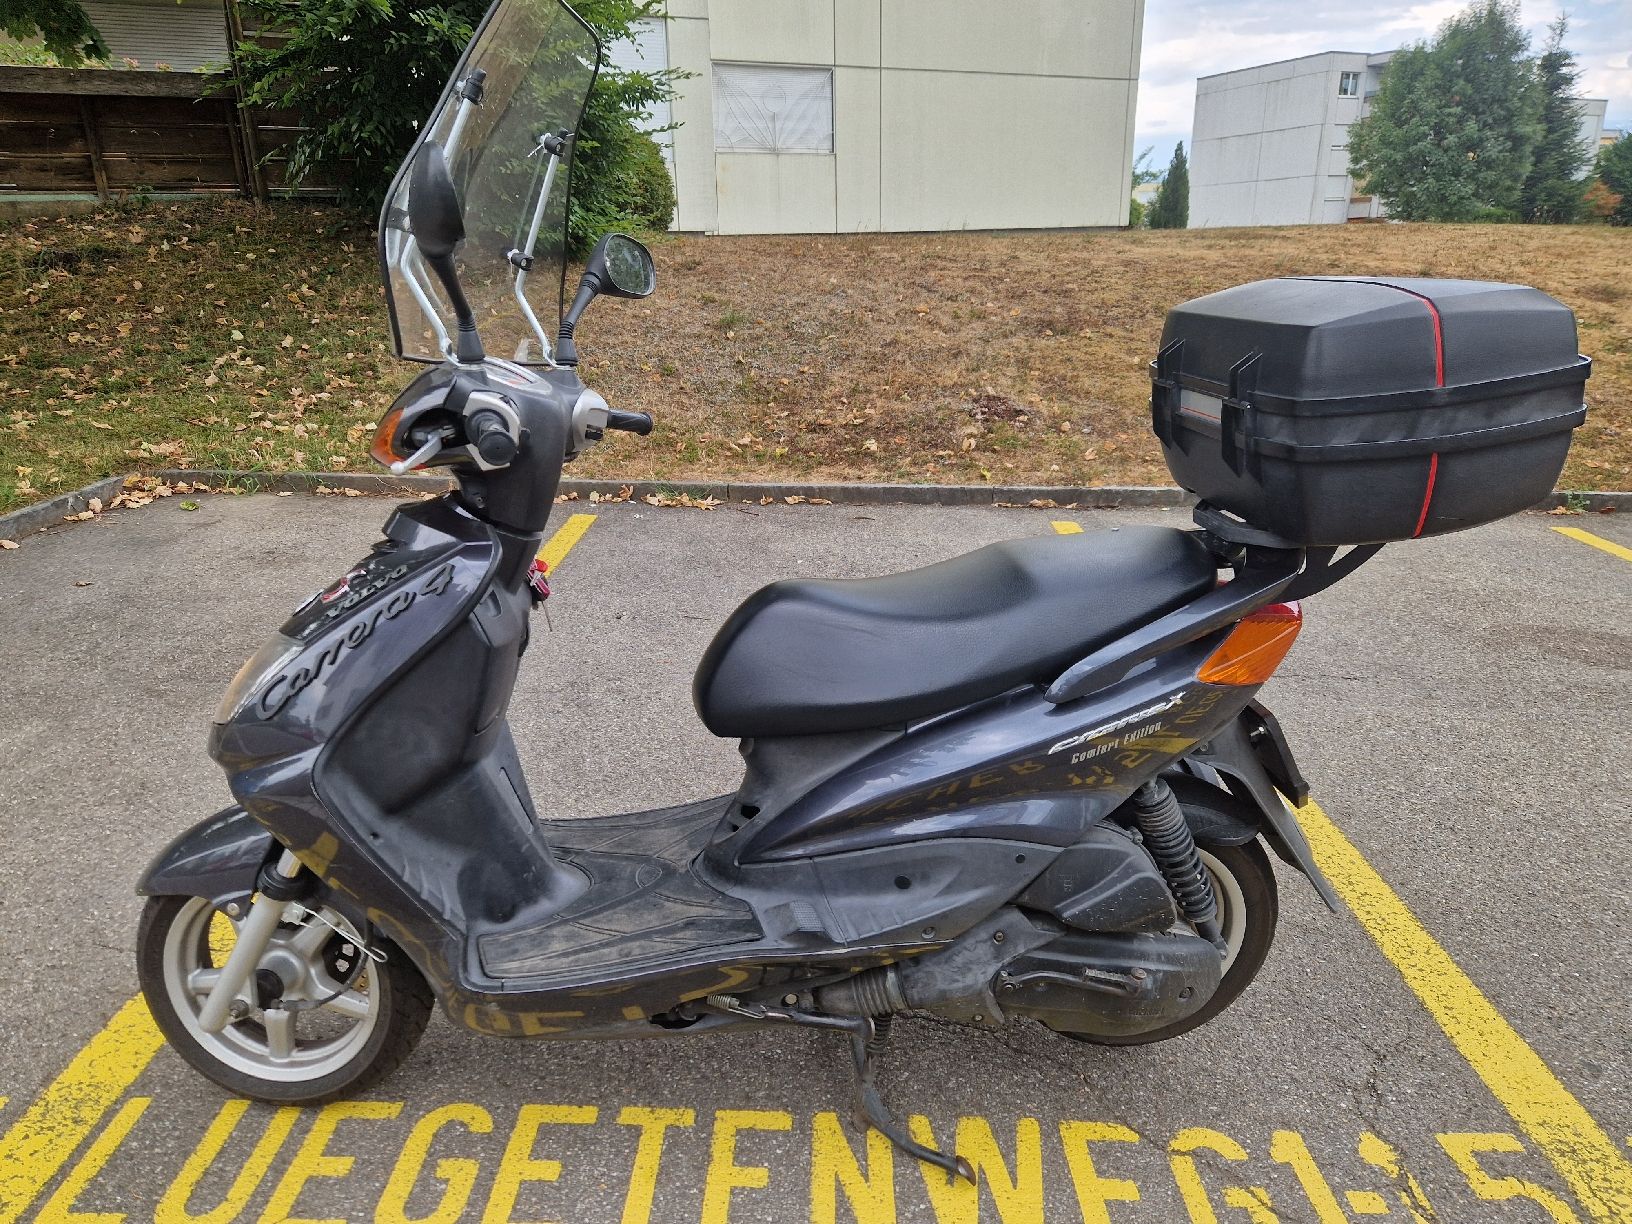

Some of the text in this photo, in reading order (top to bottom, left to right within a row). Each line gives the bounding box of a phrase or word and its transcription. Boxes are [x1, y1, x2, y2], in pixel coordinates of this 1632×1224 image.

[255, 563, 457, 721] Carrera 4
[1071, 721, 1162, 765] Comfort Edition
